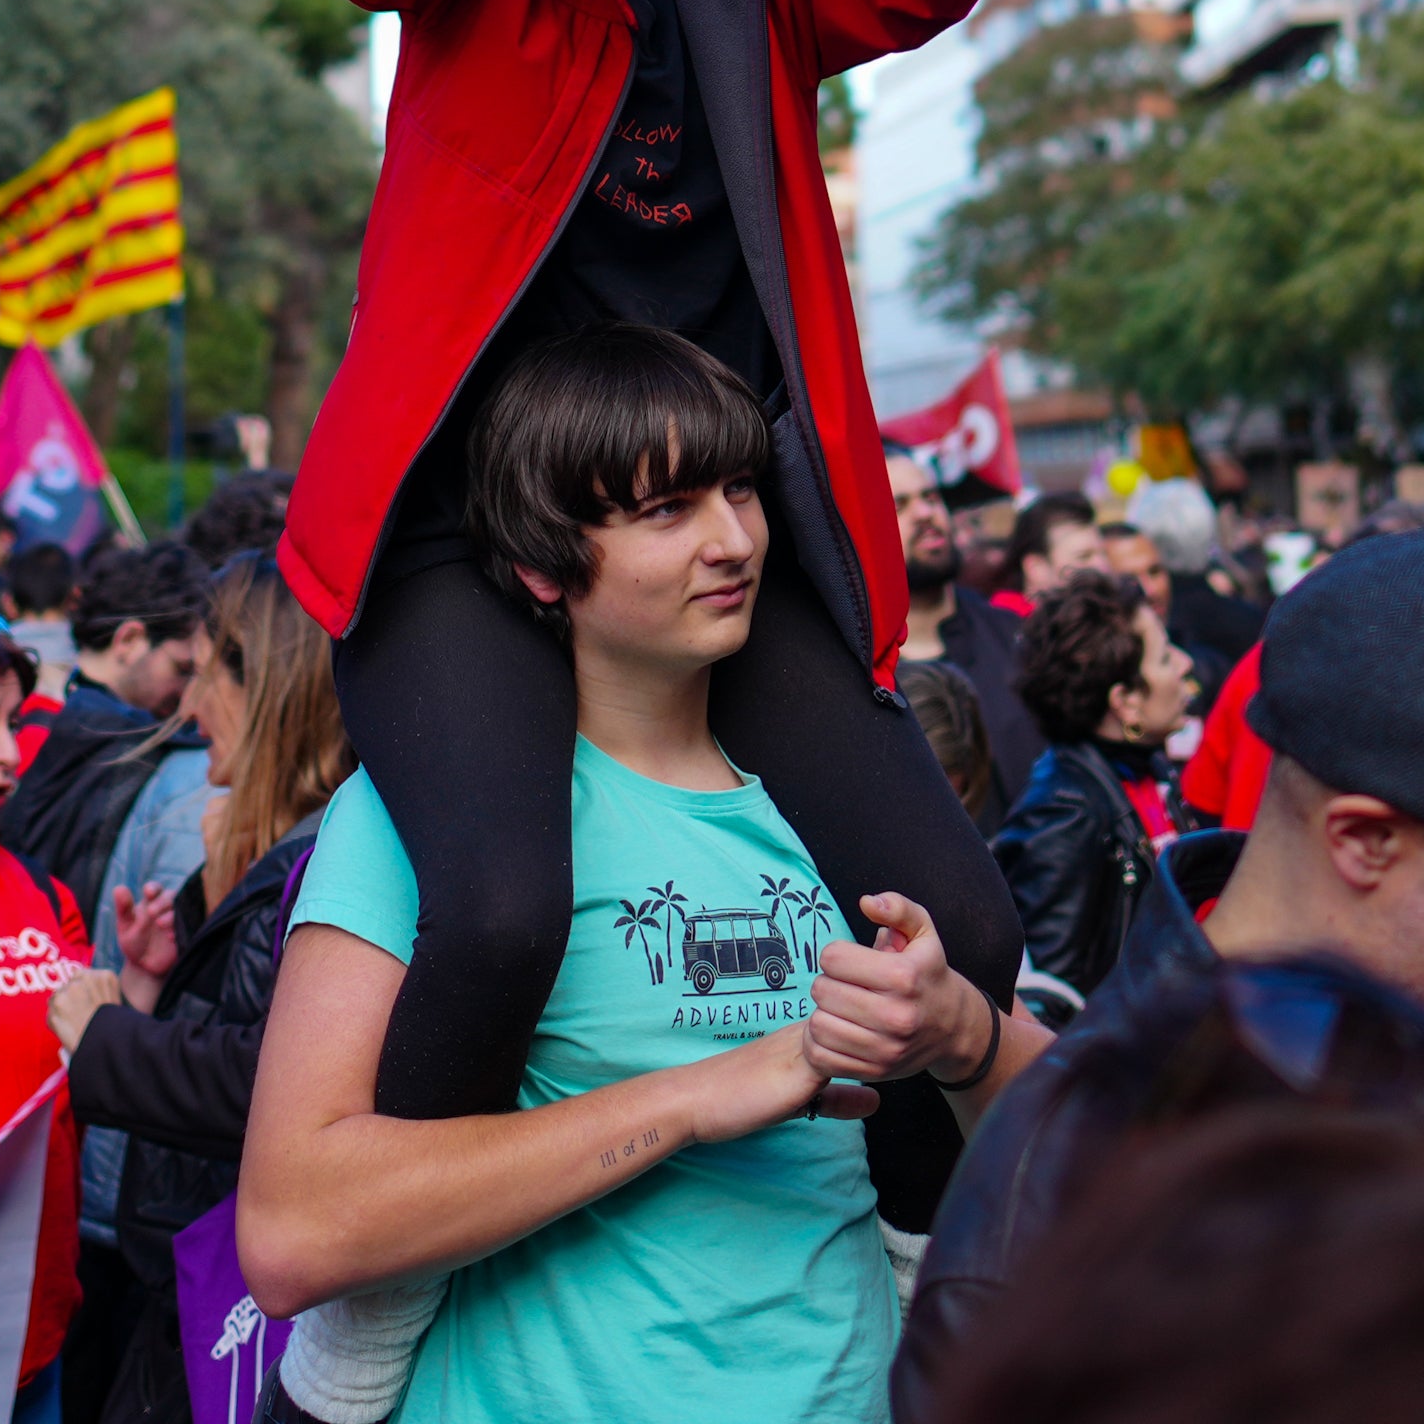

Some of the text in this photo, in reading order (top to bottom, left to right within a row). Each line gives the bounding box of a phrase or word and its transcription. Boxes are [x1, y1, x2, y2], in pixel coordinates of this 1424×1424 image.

[594, 173, 693, 227] LEADER
[671, 997, 809, 1029] ADVENTURE
[747, 1030, 766, 1039] SURF
[623, 1139, 636, 1157] of
